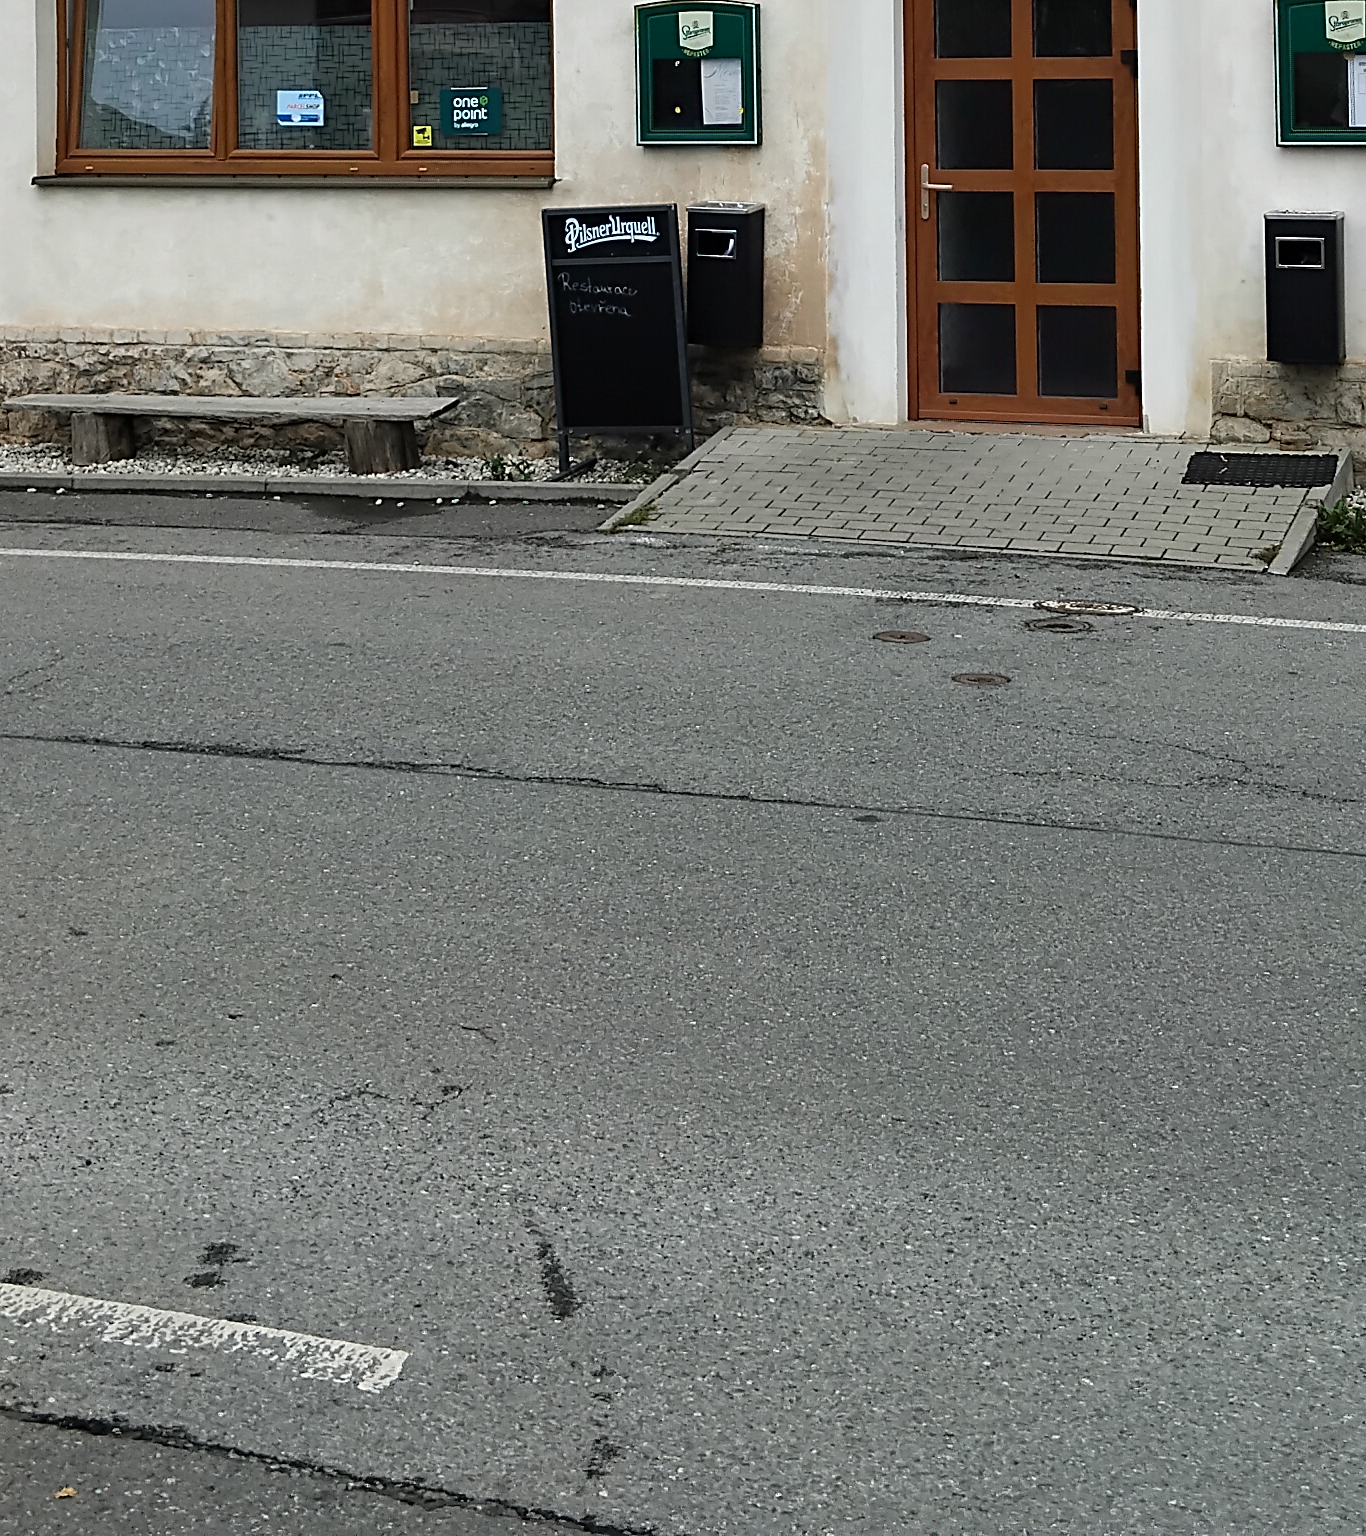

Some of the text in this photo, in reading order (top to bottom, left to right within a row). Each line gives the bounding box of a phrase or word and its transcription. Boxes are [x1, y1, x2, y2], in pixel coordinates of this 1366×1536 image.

[453, 97, 479, 108] one
[453, 107, 488, 122] point
[565, 214, 656, 253] Pilsner Urquell
